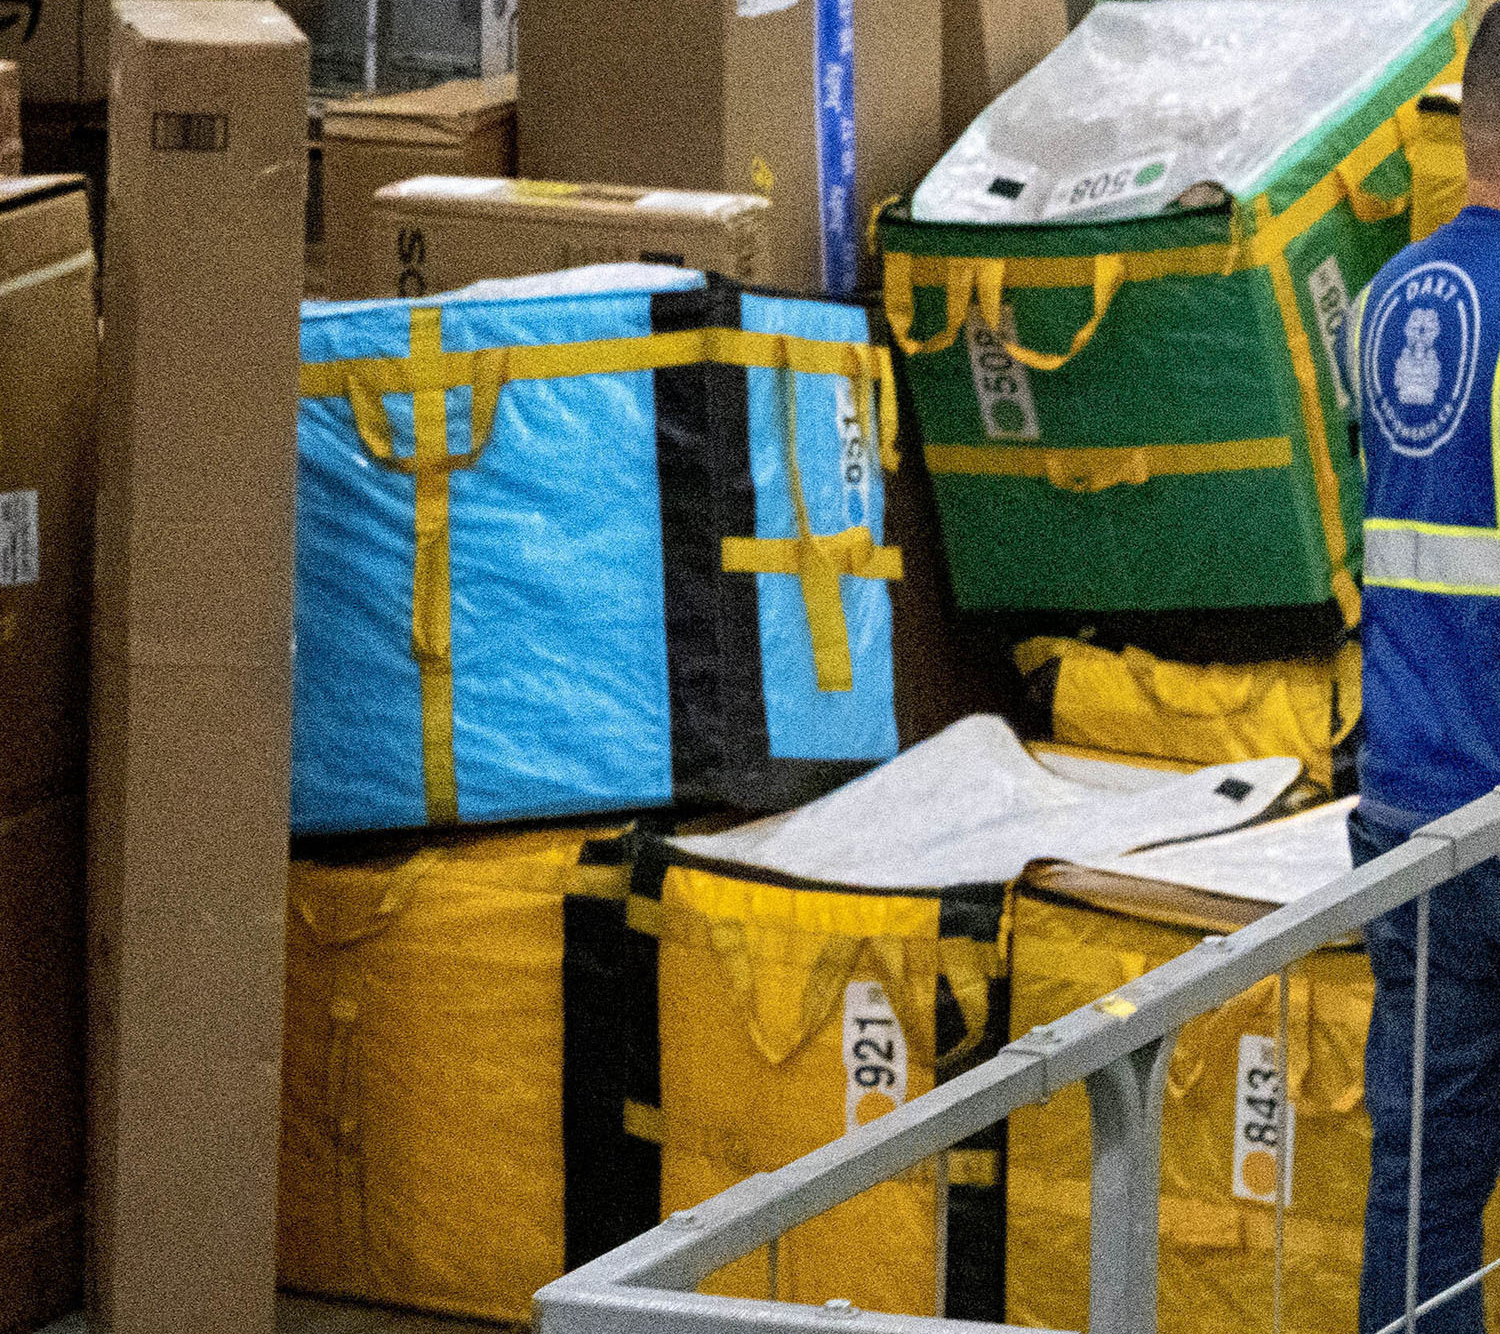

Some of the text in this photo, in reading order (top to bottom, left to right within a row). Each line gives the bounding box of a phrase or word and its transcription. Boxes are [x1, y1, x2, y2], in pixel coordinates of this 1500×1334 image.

[1068, 171, 1132, 207] 508
[852, 1015, 897, 1090] 921
[1244, 1068, 1279, 1148] 843
